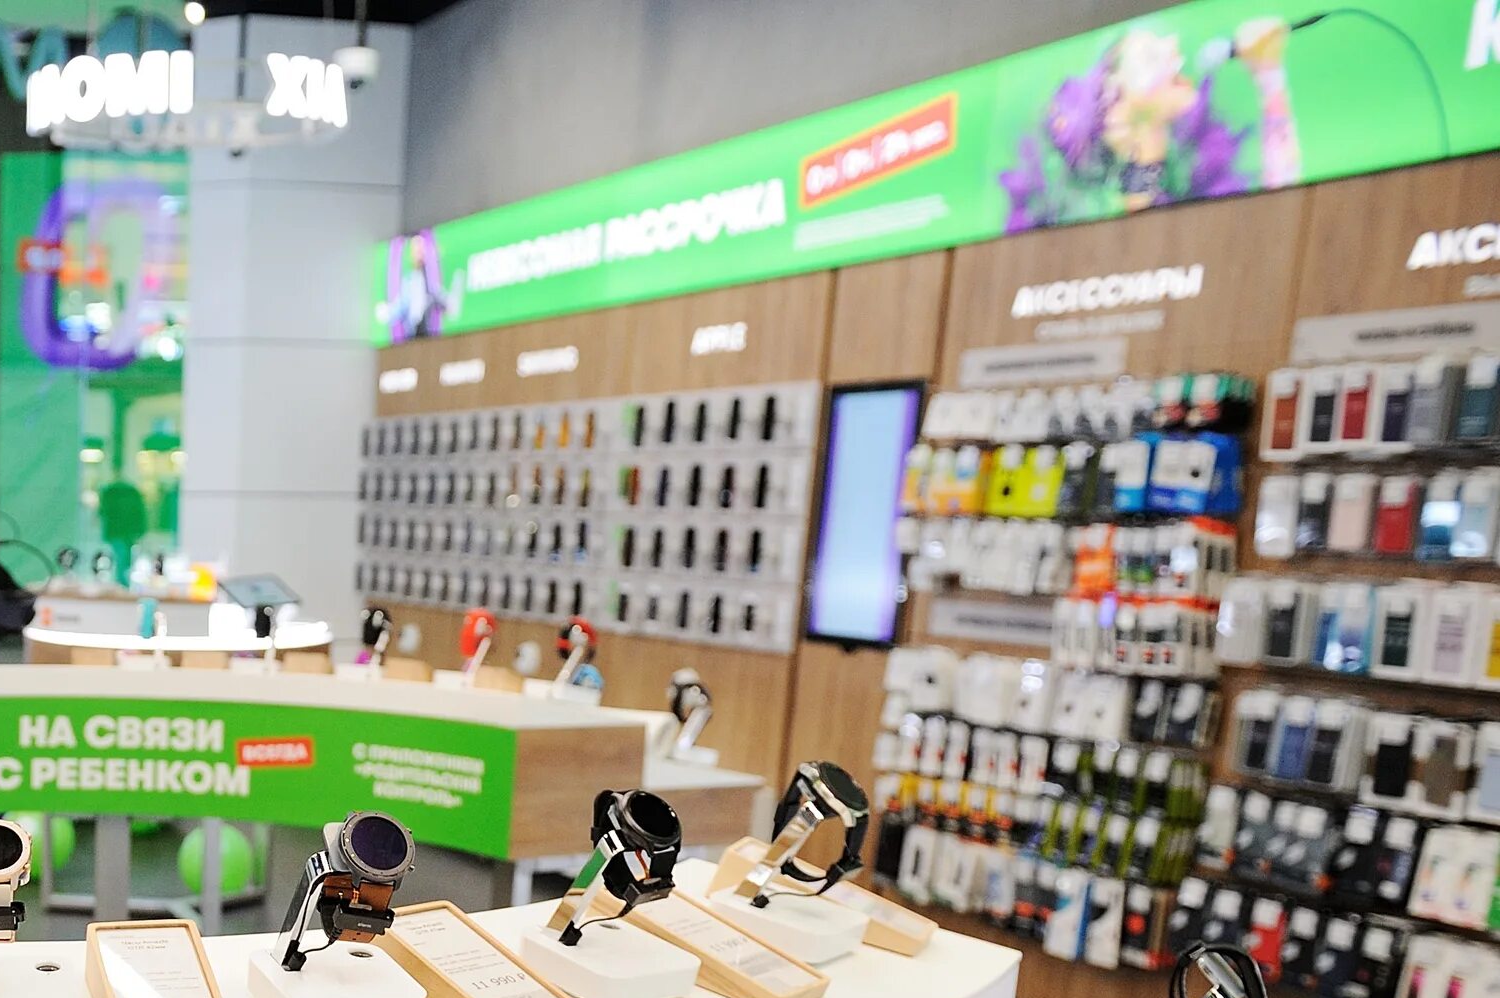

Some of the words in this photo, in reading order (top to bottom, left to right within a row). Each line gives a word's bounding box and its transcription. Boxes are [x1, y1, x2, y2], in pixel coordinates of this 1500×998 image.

[603, 178, 787, 263] РАССРОЧКА
[1406, 222, 1500, 271] АКС
[19, 715, 76, 748] НА
[84, 715, 224, 753] СВЯЗИ
[31, 757, 250, 797] РЕБЕНКОМ
